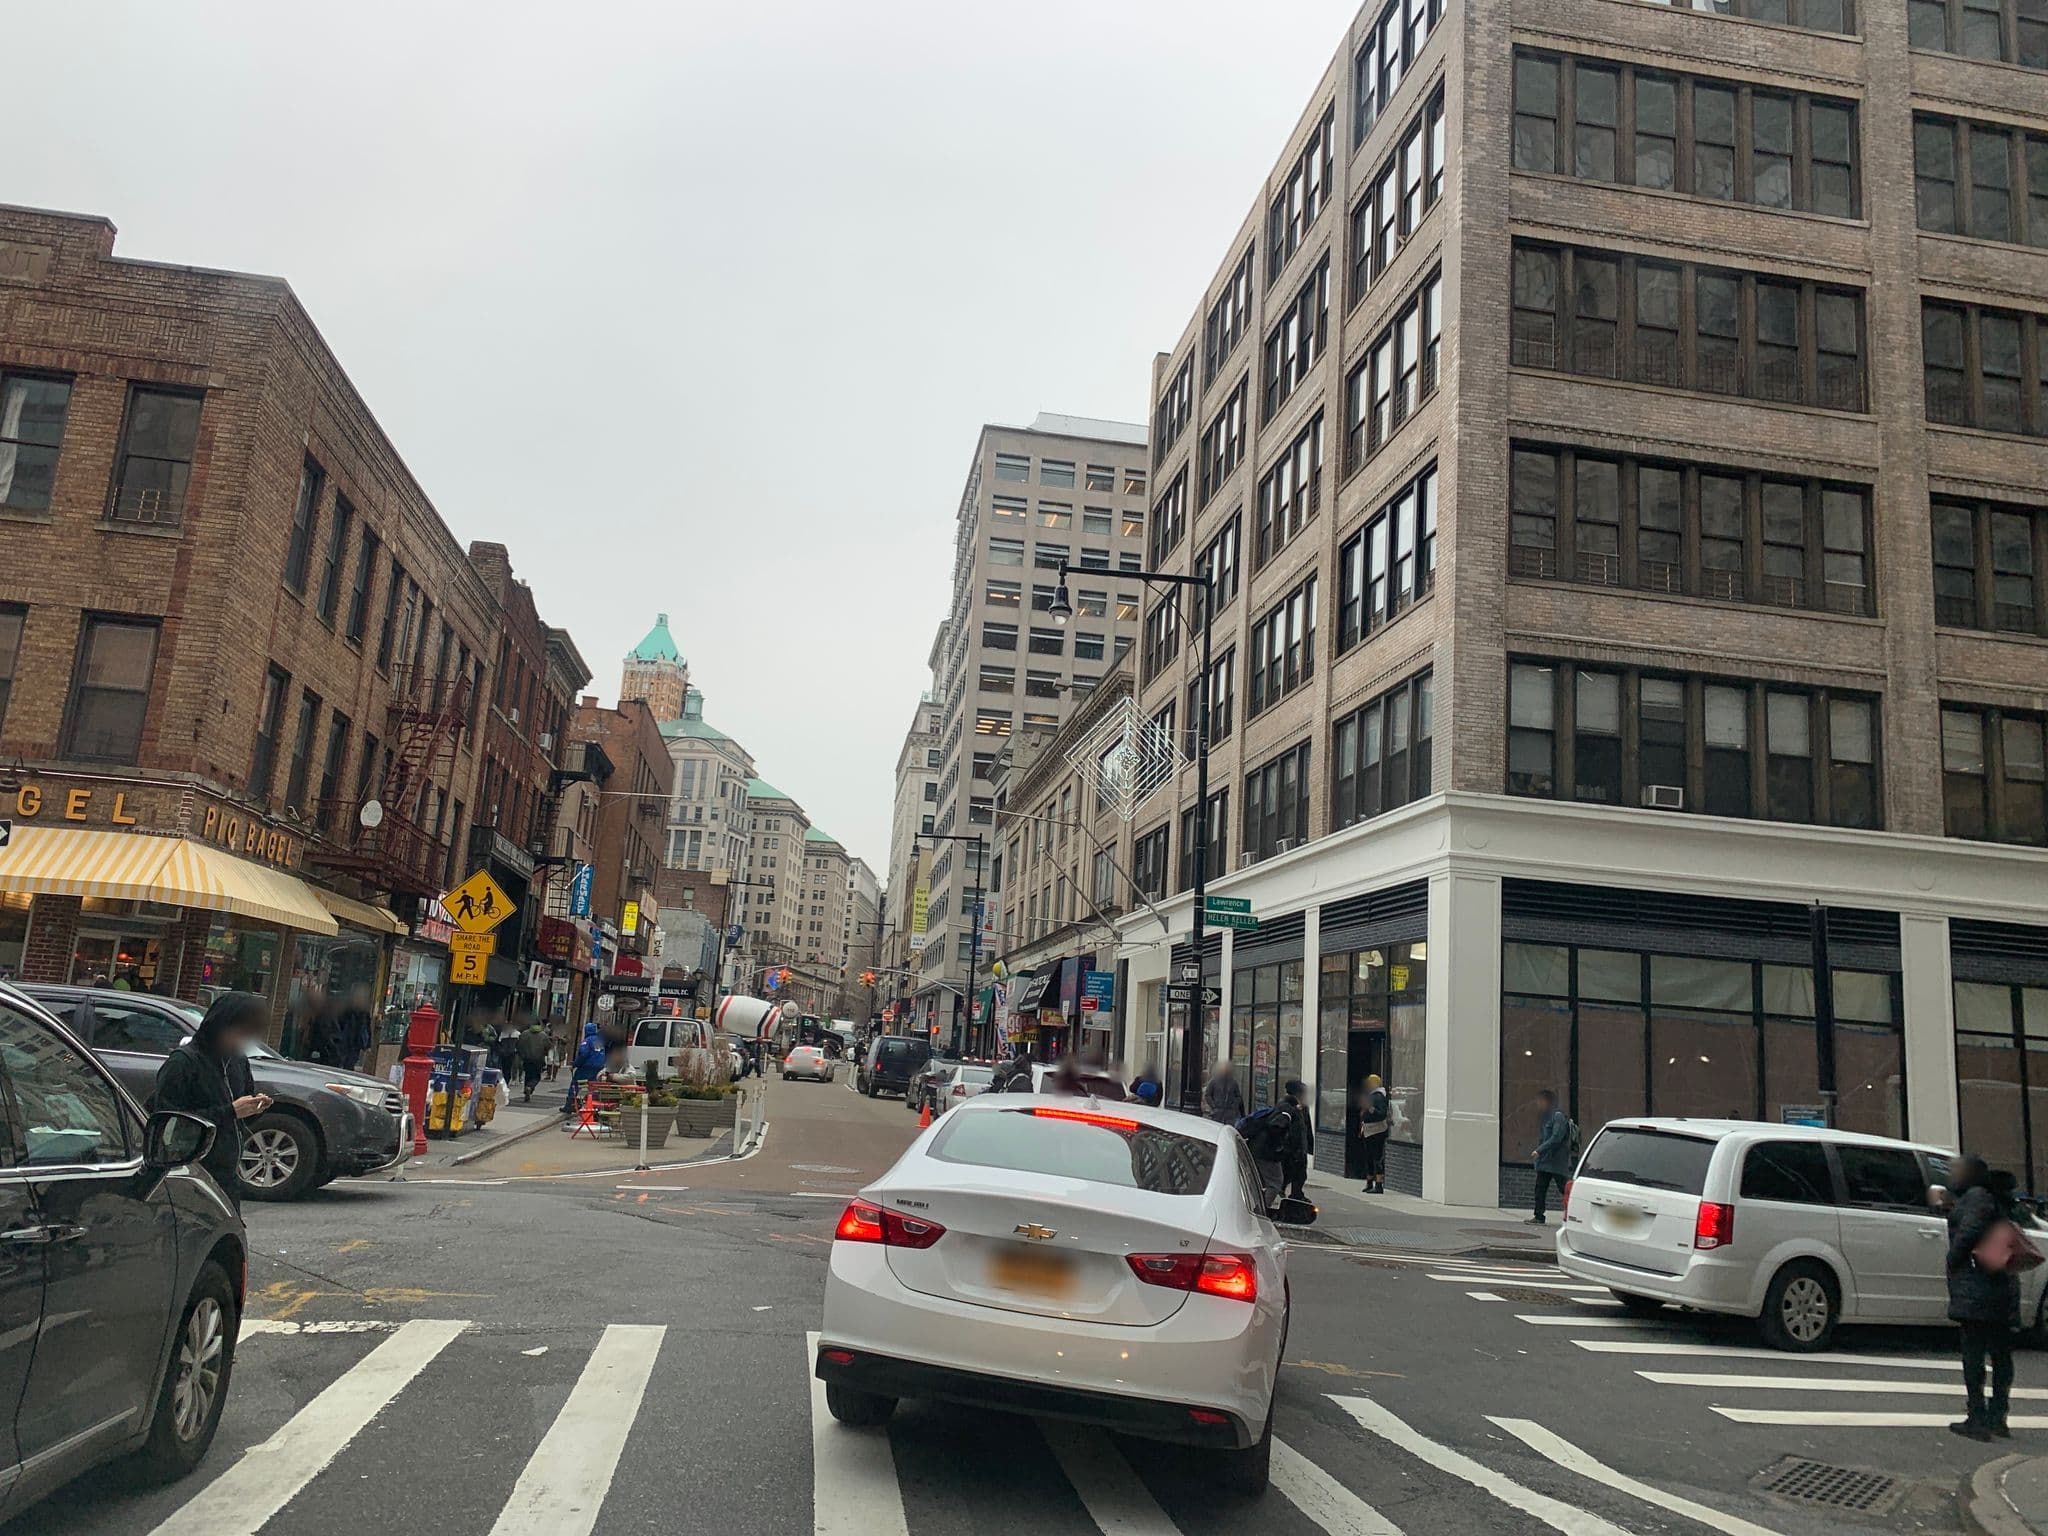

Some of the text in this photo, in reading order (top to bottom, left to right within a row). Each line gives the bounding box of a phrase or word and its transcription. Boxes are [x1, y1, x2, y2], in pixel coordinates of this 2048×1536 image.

[204, 806, 293, 866] PIQ BAGEL
[1212, 897, 1245, 907] Lawrence
[1207, 913, 1230, 922] HELEN
[1231, 916, 1257, 925] KELLER
[456, 934, 491, 943] SHARE THE
[463, 942, 481, 950] ROAD
[463, 955, 477, 971] 5
[1174, 990, 1191, 999] ONE
